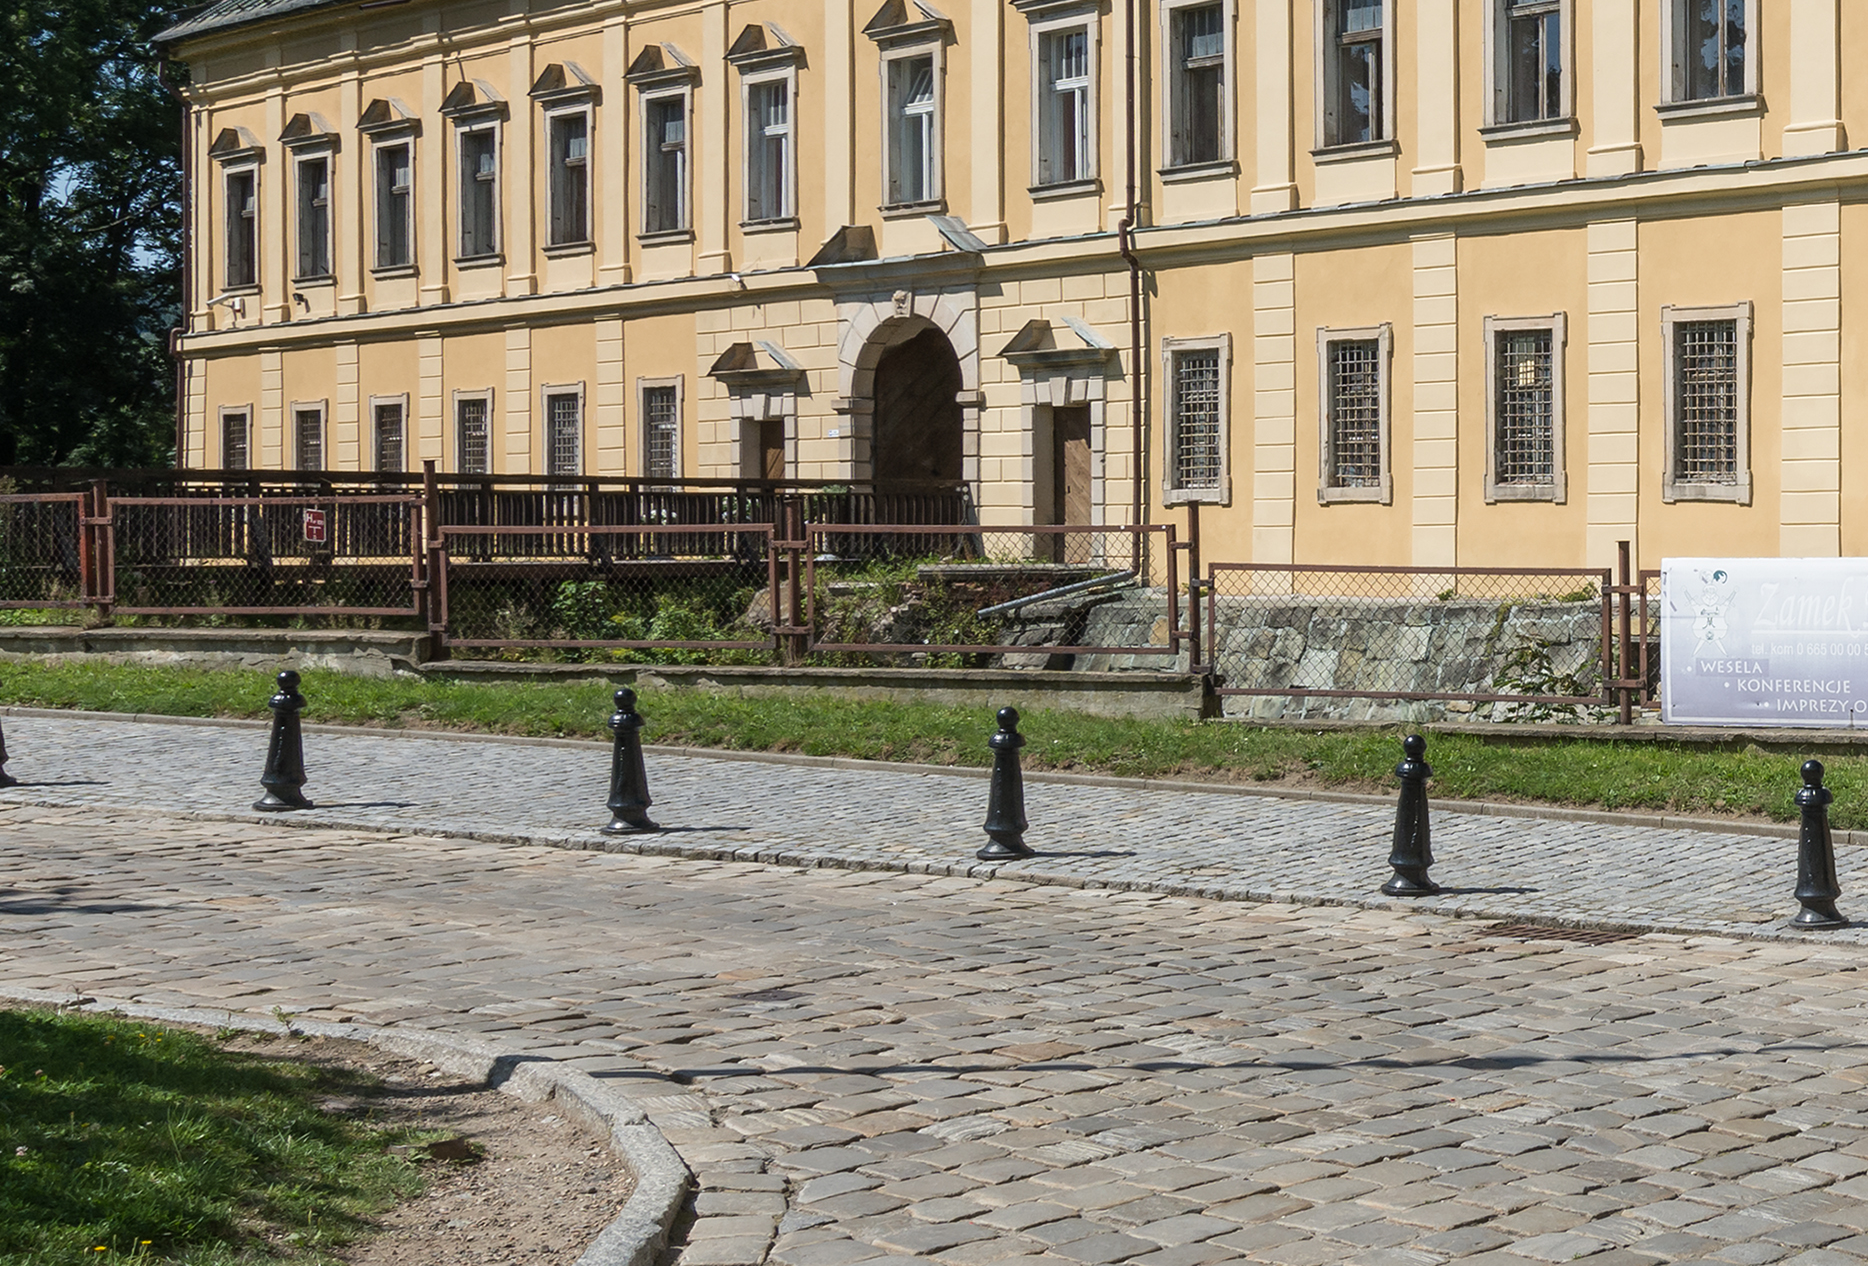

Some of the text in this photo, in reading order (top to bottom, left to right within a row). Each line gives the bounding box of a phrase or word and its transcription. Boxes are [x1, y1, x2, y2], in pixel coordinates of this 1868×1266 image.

[1753, 576, 1861, 638] Zamek
[1751, 642, 1768, 656] tel.
[1770, 642, 1794, 656] kom
[1796, 642, 1804, 656] 0
[1806, 643, 1827, 656] 665
[1829, 643, 1844, 657] 00
[1846, 643, 1862, 657] 00
[1700, 660, 1763, 674] WESELA
[1737, 679, 1851, 694] KONFERENCJE
[1776, 699, 1849, 713] IMPREZY
